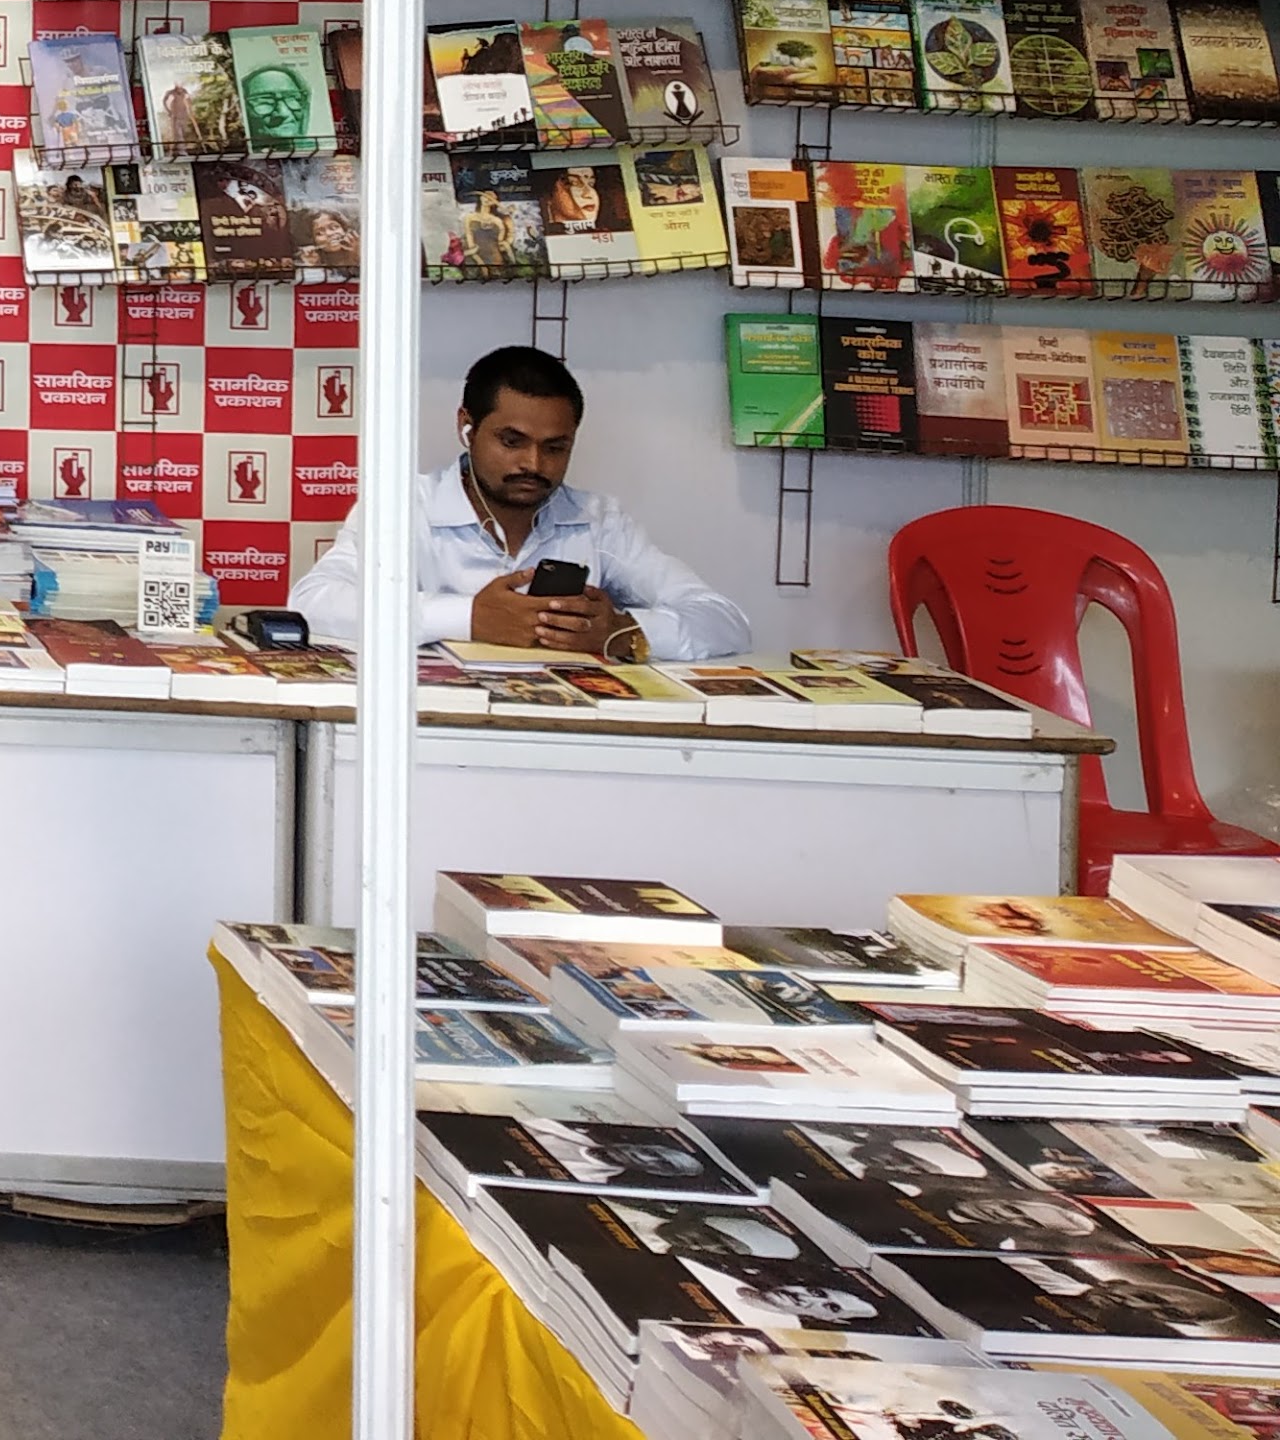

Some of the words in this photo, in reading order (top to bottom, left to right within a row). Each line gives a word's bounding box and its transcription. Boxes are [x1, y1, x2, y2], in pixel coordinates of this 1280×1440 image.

[33, 370, 113, 389] सामयिक
[208, 373, 290, 393] सामयिक
[39, 391, 107, 405] प्रकाशन
[214, 394, 283, 408] प्रकाशन
[207, 547, 286, 566] सामयिक
[212, 567, 280, 581] प्रकाशन
